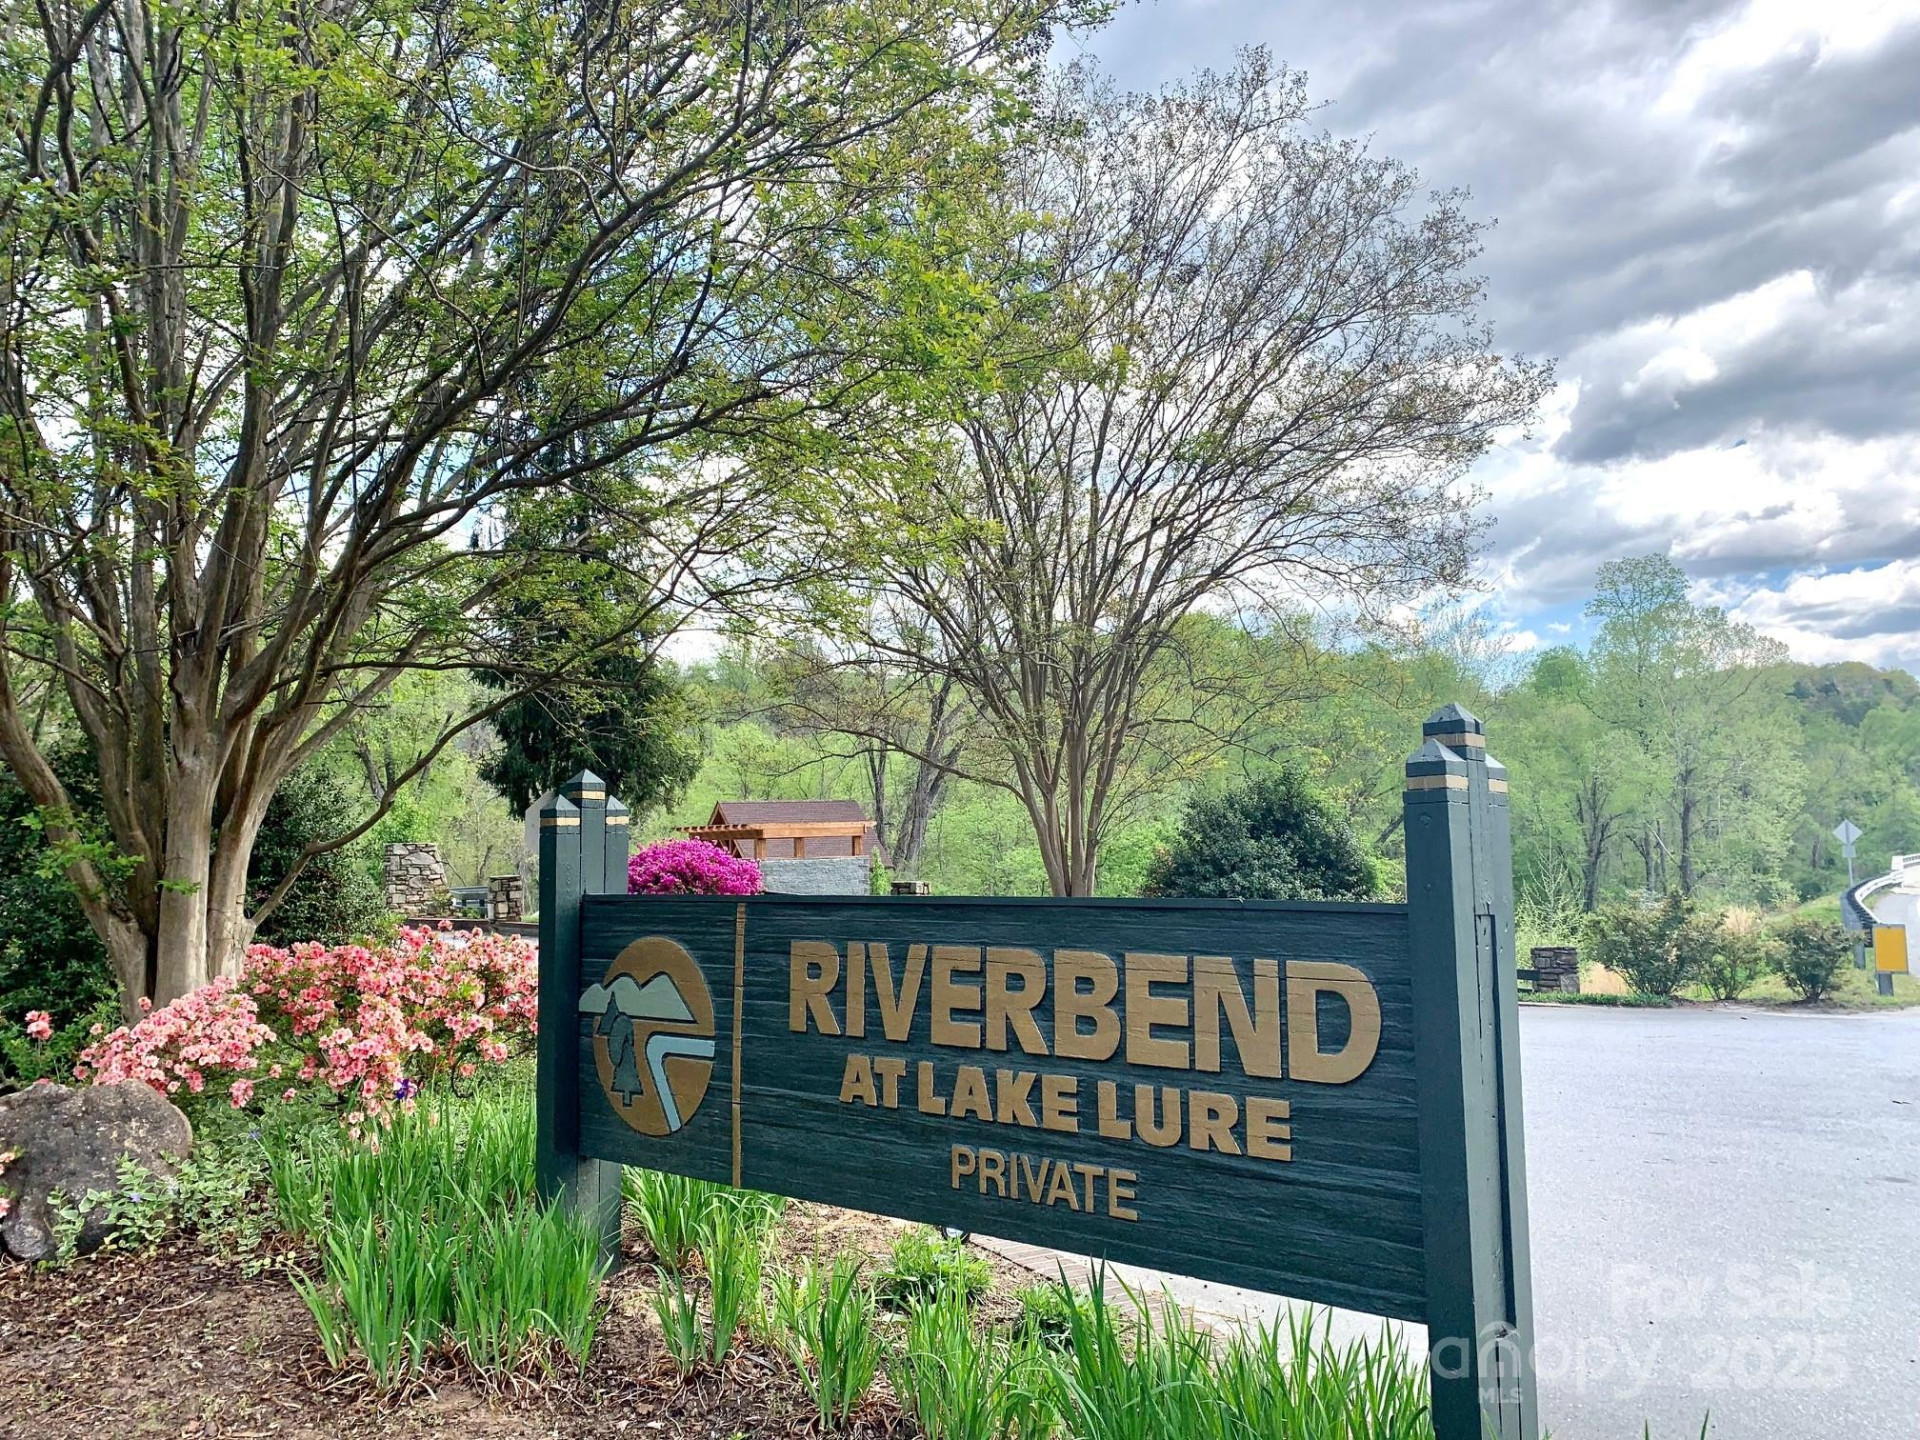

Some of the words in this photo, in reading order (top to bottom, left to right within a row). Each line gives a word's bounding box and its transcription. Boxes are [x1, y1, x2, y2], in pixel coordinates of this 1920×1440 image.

[789, 939, 1382, 1084] RIVERBEND
[839, 1054, 905, 1107] AT
[917, 1062, 1079, 1132] LAKE
[1097, 1080, 1292, 1162] LURE
[951, 1144, 1138, 1221] PRIVATE
